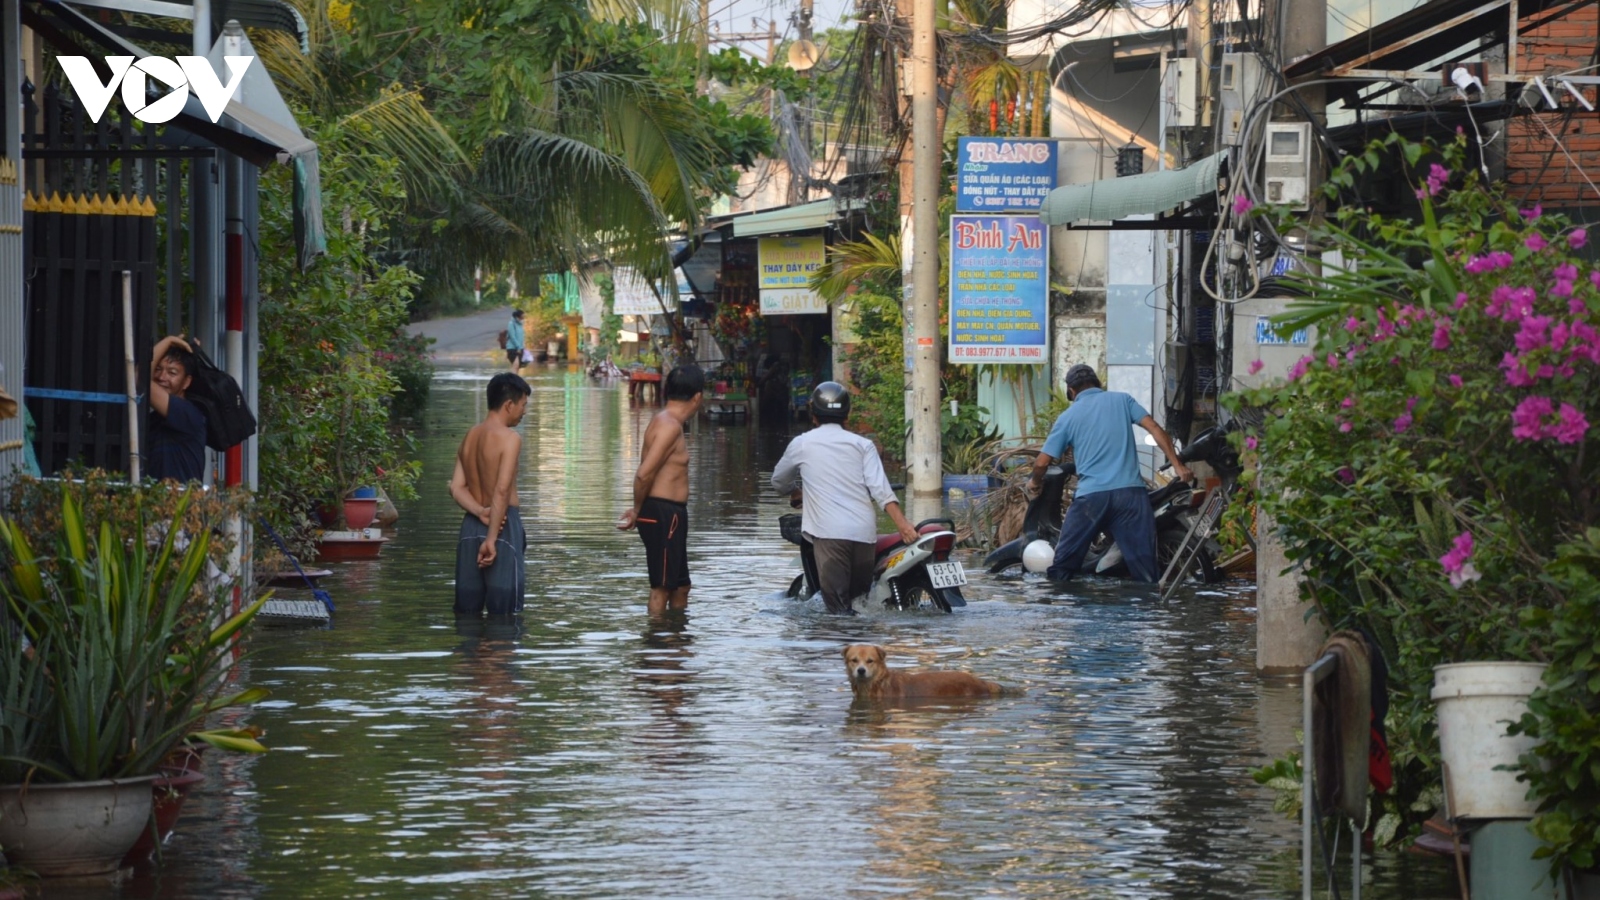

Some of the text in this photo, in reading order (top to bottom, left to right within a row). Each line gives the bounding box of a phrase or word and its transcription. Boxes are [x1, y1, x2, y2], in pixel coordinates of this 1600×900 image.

[967, 142, 1049, 163] TRANG
[963, 173, 978, 183] SỬA
[1002, 174, 1012, 184] ÁO
[1013, 174, 1030, 185] (CÁC
[984, 185, 998, 195] NÚT
[1004, 187, 1020, 196] THAY
[1022, 186, 1036, 196] DÂY
[956, 220, 1042, 252] Bình An
[763, 264, 783, 273] THAY
[786, 262, 802, 272] DÂY
[1007, 270, 1021, 279] SINH
[782, 292, 809, 312] GIẶT
[975, 334, 989, 342] SINH
[1019, 347, 1041, 357] TRUNG)
[932, 562, 958, 576] 63-C1
